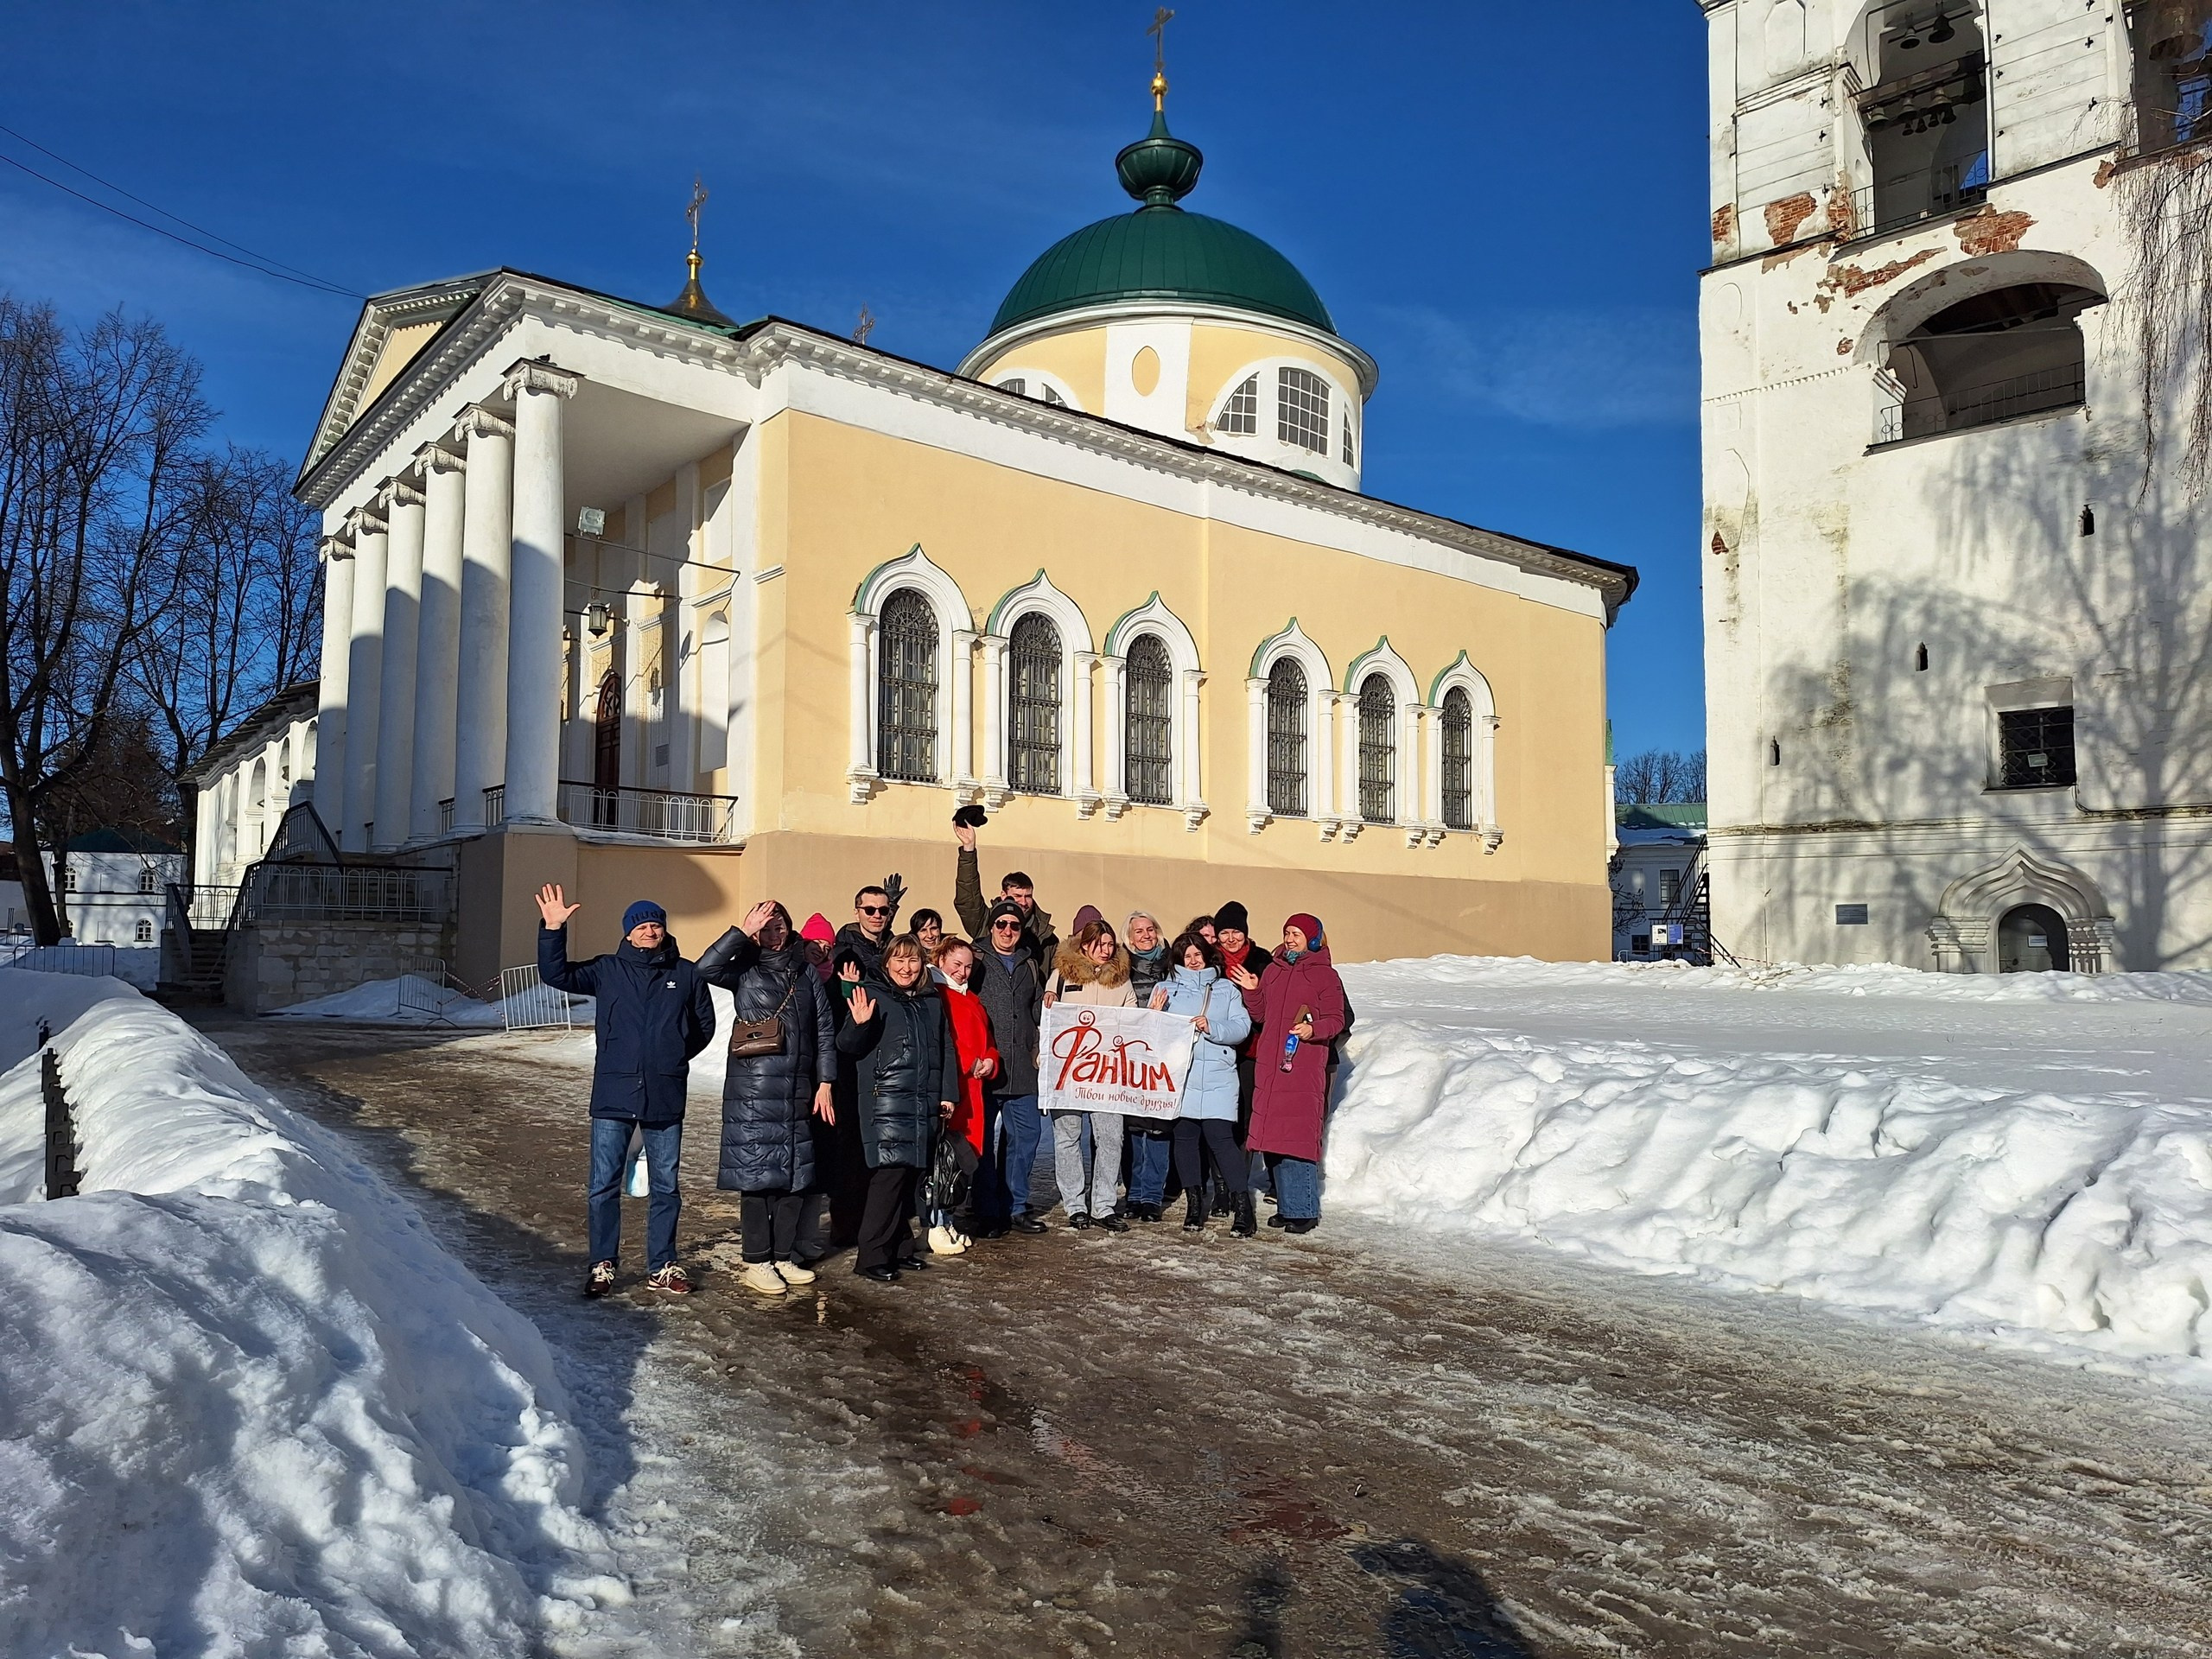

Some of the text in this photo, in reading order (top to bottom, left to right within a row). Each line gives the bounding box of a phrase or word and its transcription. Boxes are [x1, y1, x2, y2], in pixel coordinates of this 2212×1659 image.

[1075, 1087, 1176, 1110] Твои новые друзья!
